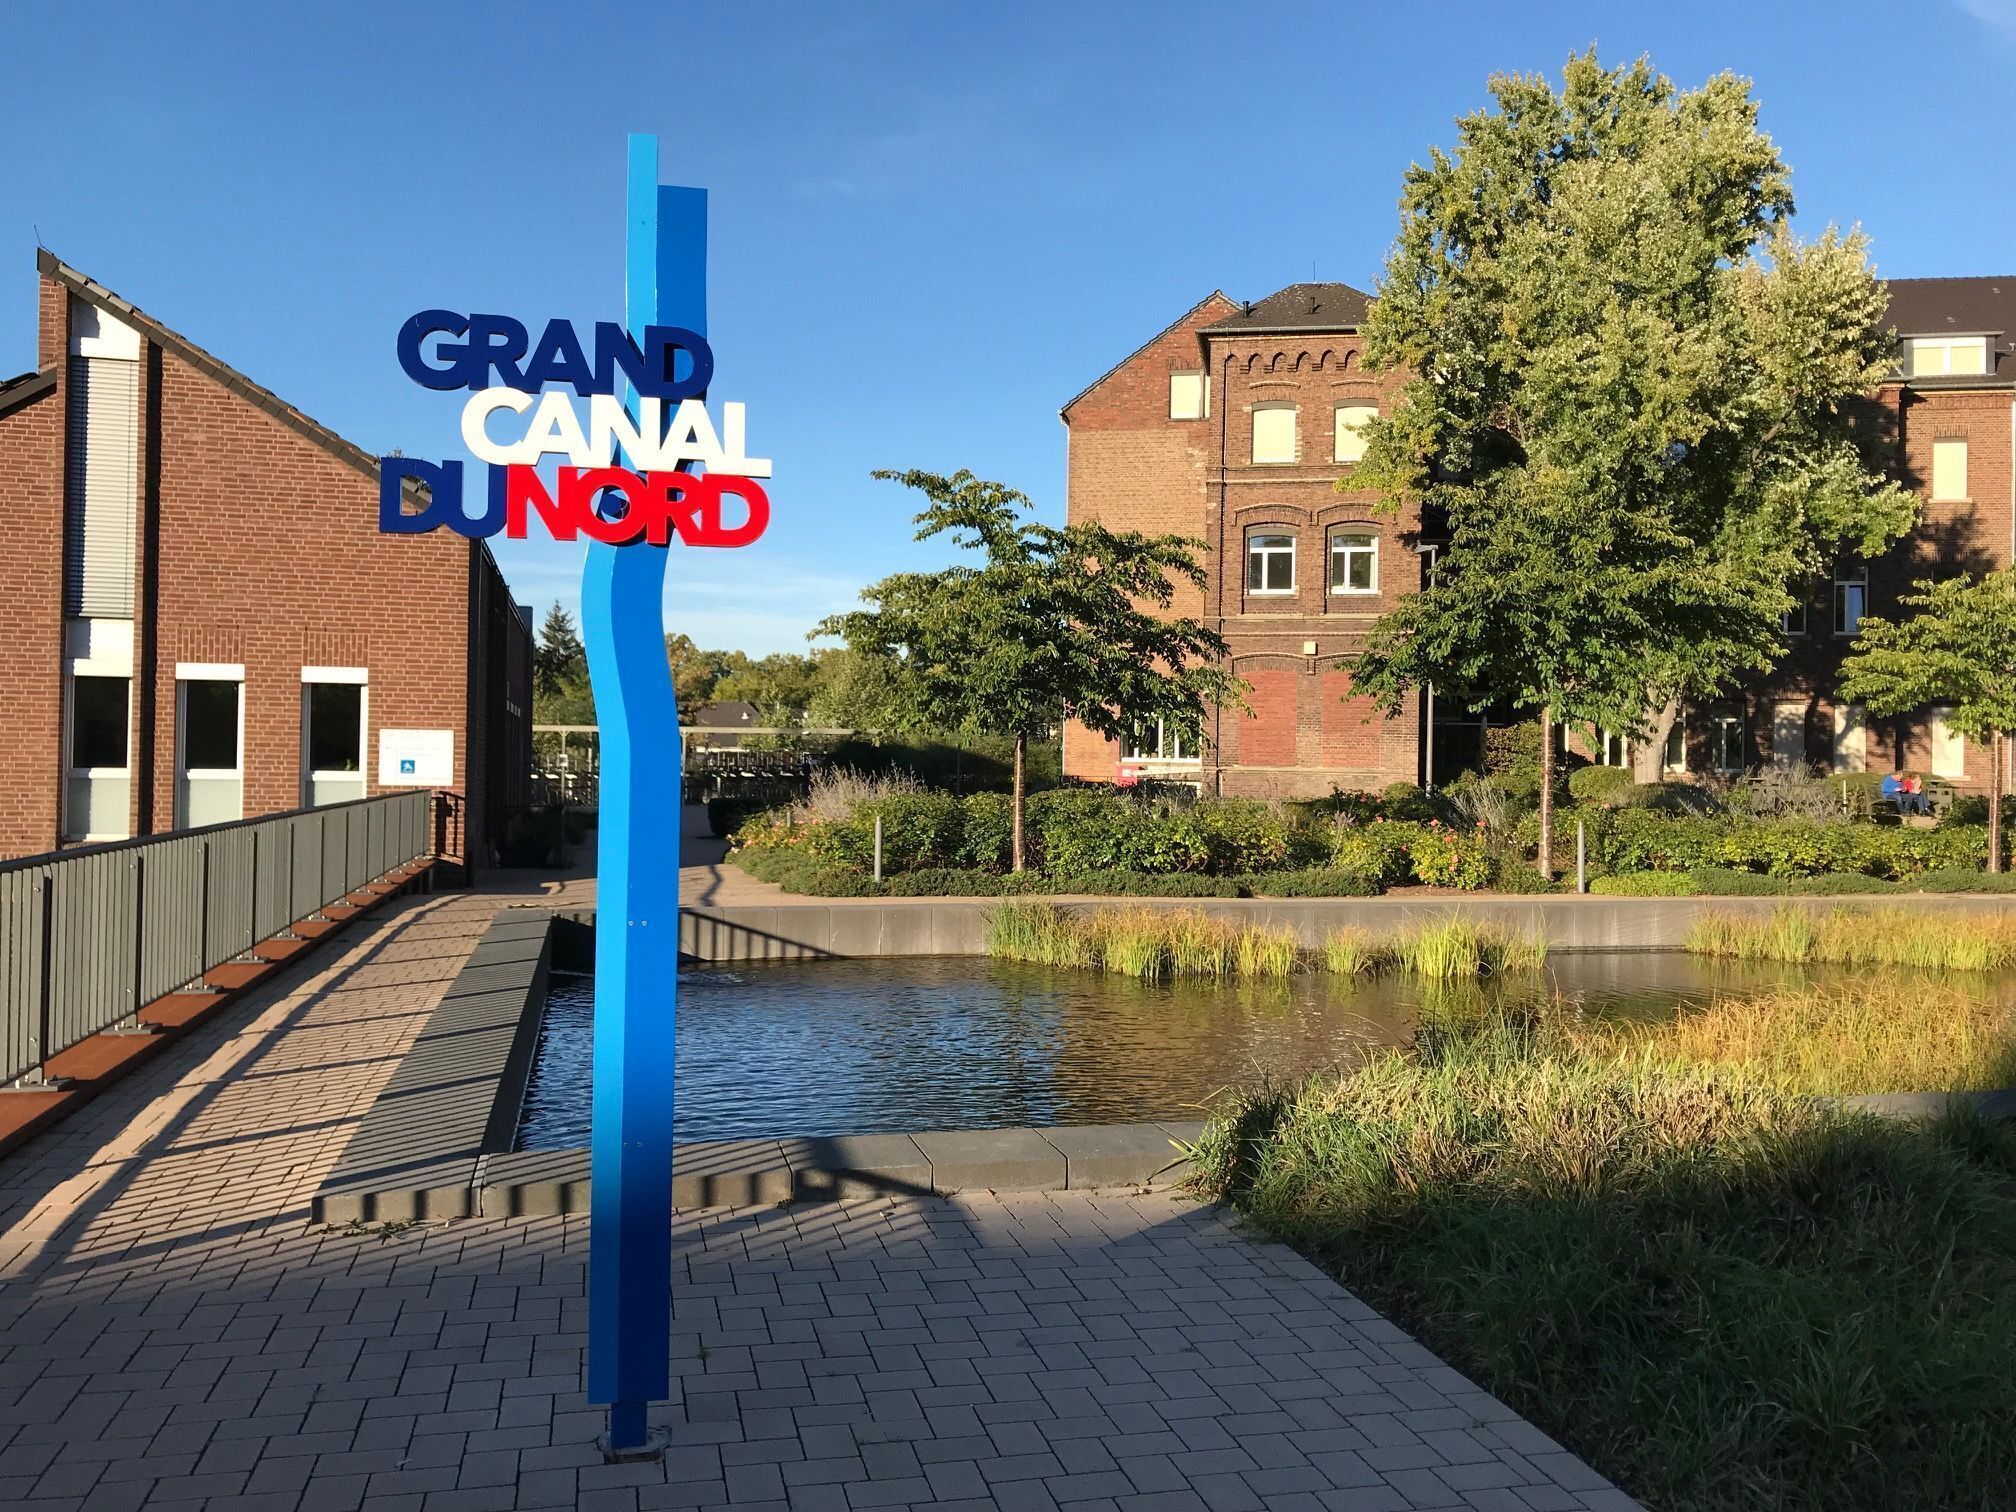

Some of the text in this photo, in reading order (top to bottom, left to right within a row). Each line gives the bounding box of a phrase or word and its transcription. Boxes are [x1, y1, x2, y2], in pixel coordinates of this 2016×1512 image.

[397, 309, 714, 399] GRAND
[461, 386, 772, 478] CANAL
[379, 456, 770, 548] DU NORD
